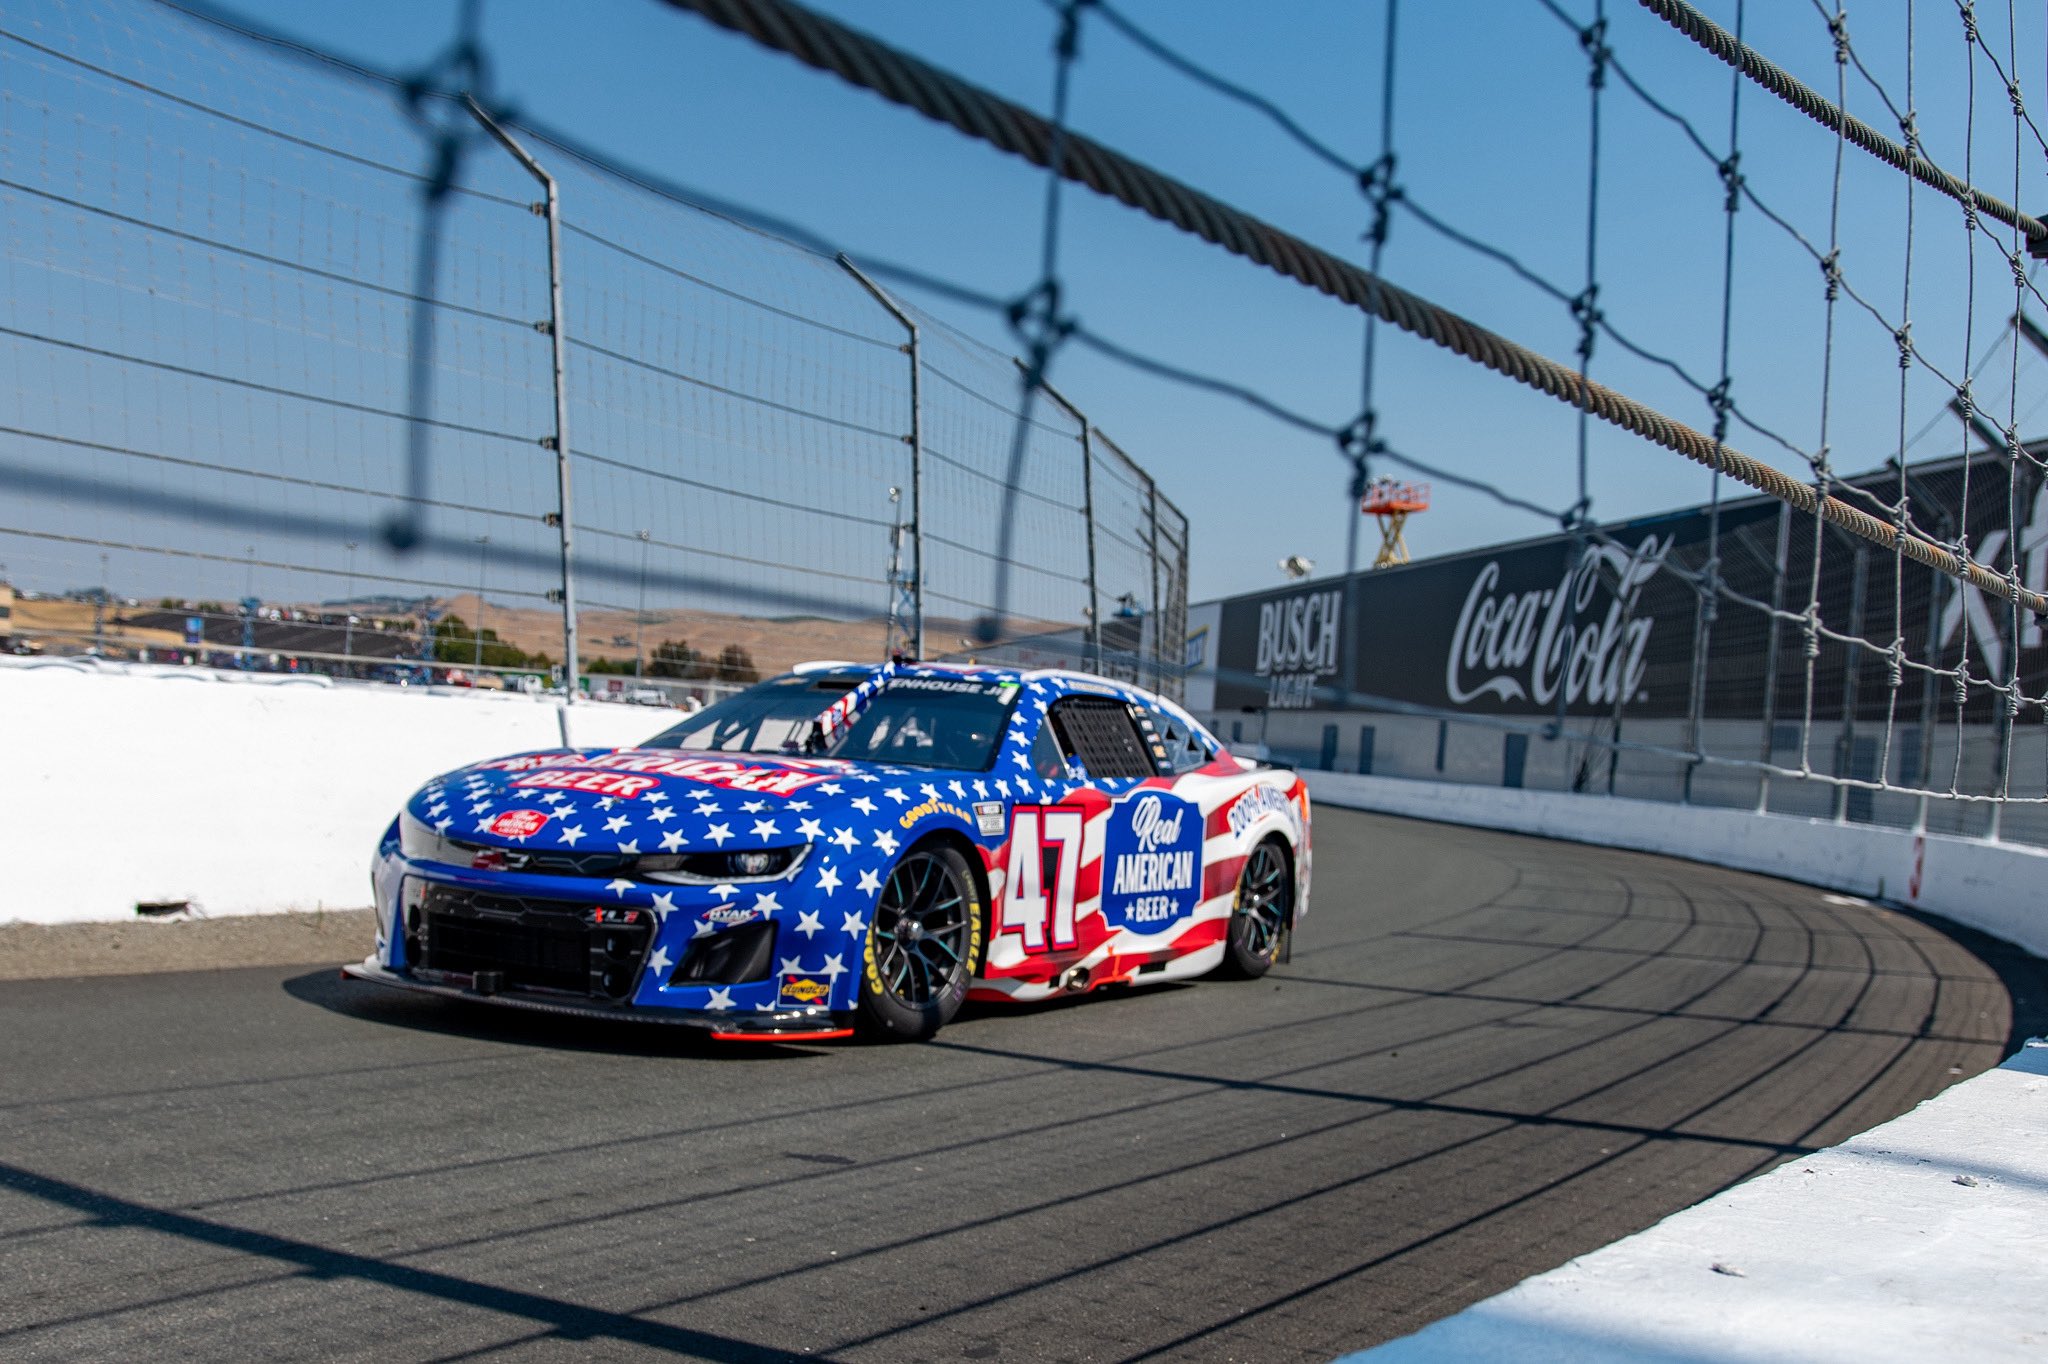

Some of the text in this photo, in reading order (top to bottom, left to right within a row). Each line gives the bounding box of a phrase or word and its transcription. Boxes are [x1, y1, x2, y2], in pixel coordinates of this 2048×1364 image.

[1255, 590, 1342, 677] BUSCH
[1446, 534, 1676, 706] Coca-Cola
[1267, 672, 1318, 709] LIGHT
[515, 770, 659, 798] BEER
[1131, 795, 1185, 852] Real
[1002, 810, 1083, 951] 47
[1112, 851, 1195, 895] AMERICAN
[1135, 896, 1169, 923] BEER
[967, 902, 982, 977] EAGLE
